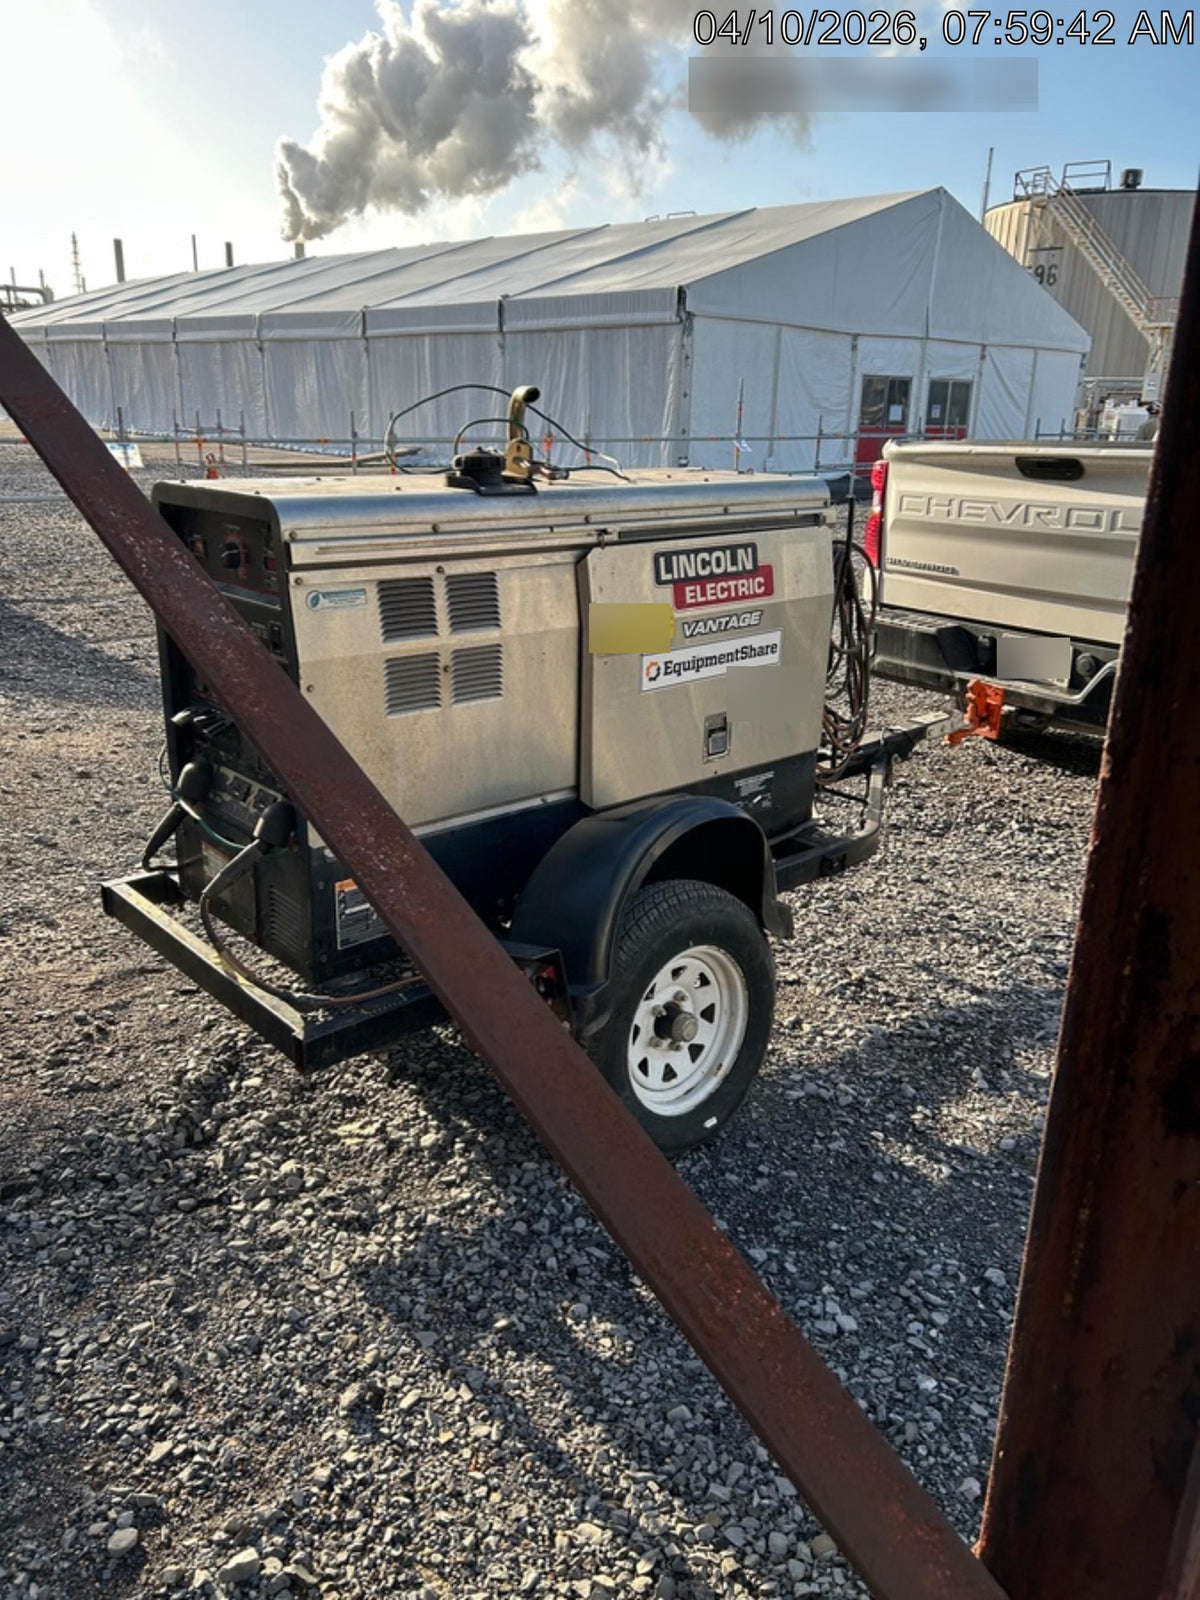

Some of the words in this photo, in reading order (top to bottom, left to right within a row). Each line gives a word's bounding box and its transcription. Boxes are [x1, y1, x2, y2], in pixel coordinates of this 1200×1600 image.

[1025, 264, 1058, 286] 96
[659, 547, 754, 581] LINCOLN
[685, 577, 766, 604] ELECTRIC
[683, 610, 763, 638] VANTAGE
[664, 643, 778, 677] EquipmentShare
